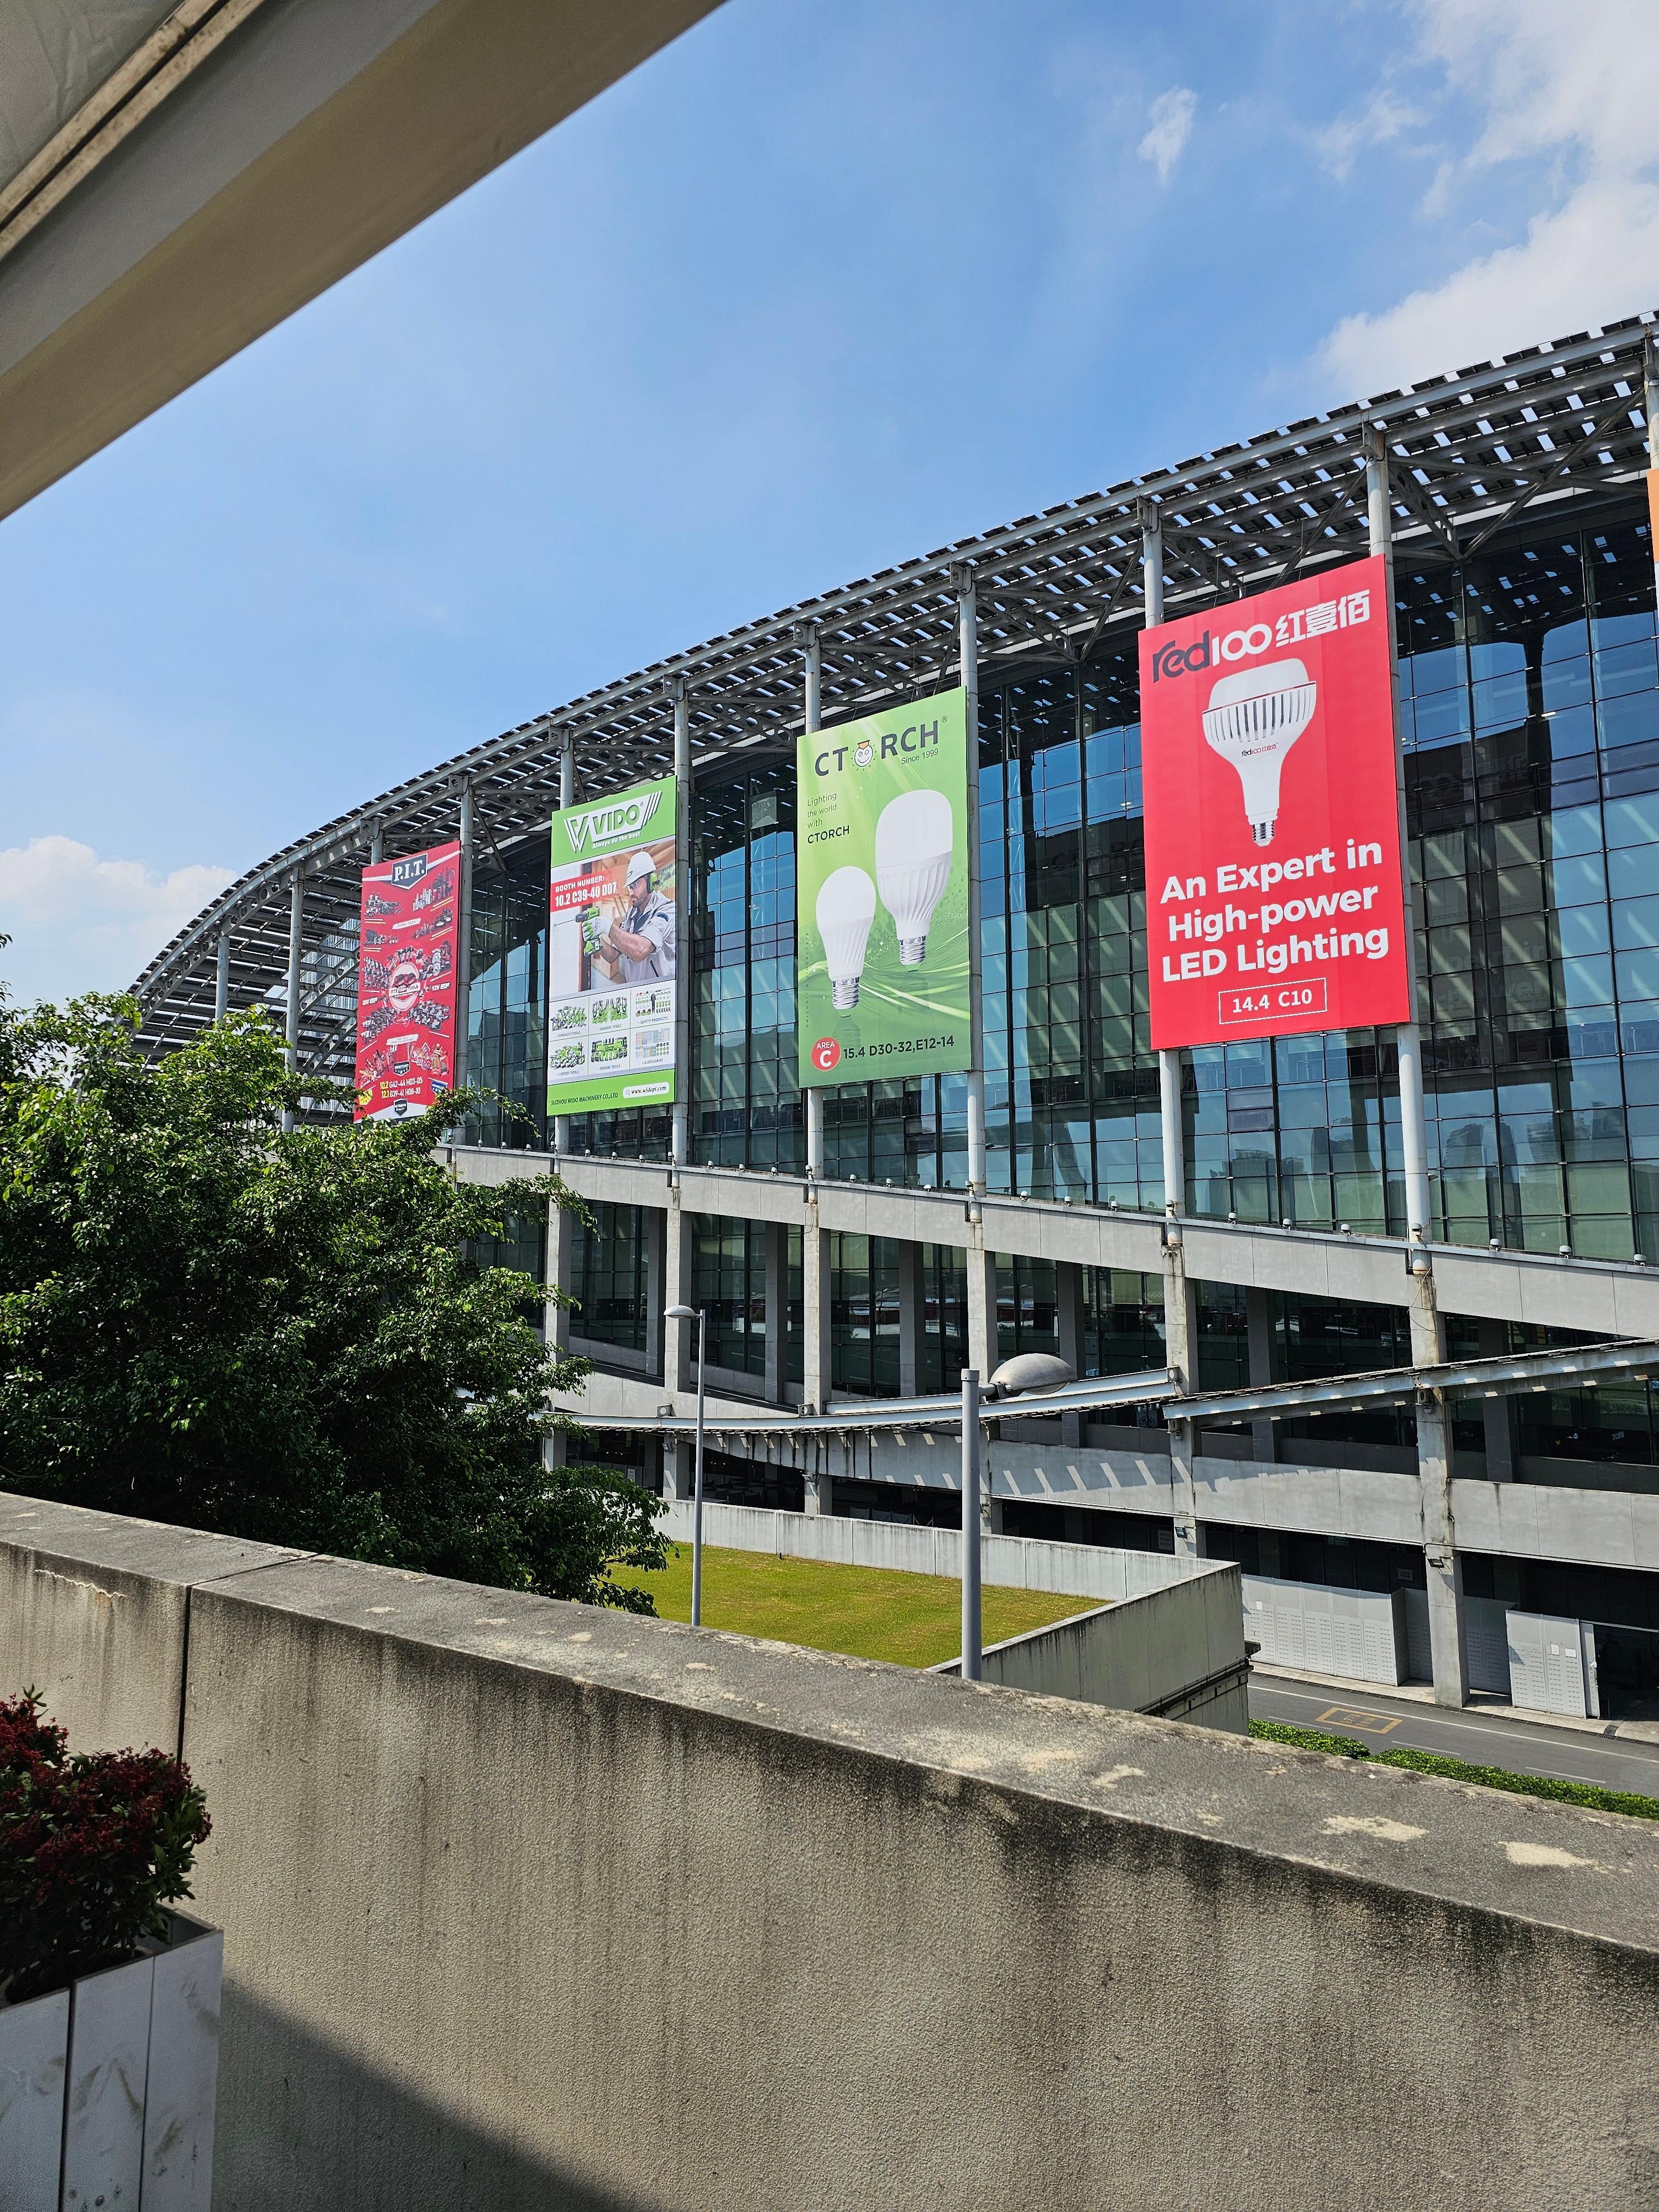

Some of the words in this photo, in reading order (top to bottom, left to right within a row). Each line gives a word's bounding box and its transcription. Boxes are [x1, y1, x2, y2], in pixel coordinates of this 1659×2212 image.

[901, 755, 920, 764] Since
[922, 748, 938, 759] 1999
[807, 793, 837, 806] Lighting
[819, 804, 837, 814] world
[807, 818, 822, 828] with
[807, 825, 849, 844] CTORCH
[592, 841, 610, 849] Always
[394, 859, 425, 881] P.I.T.
[1160, 875, 1206, 904] An
[1217, 847, 1335, 892] Expert
[1347, 838, 1382, 869] in
[555, 882, 576, 893] BOOTH
[577, 875, 604, 887] NUMBER:
[555, 893, 571, 907] 10.2
[572, 885, 601, 904] C39-40
[602, 881, 617, 896] D07
[1169, 885, 1378, 942] High-power
[1162, 948, 1227, 982] LED
[1237, 927, 1389, 974] Lighting
[1232, 994, 1270, 1013] 14.4
[1278, 988, 1312, 1007] C10
[817, 1041, 835, 1049] AREA
[843, 1047, 865, 1059] 15.4
[869, 1035, 954, 1056] D30-32,E12-14
[820, 1050, 832, 1067] C
[380, 1081, 389, 1089] 10.2
